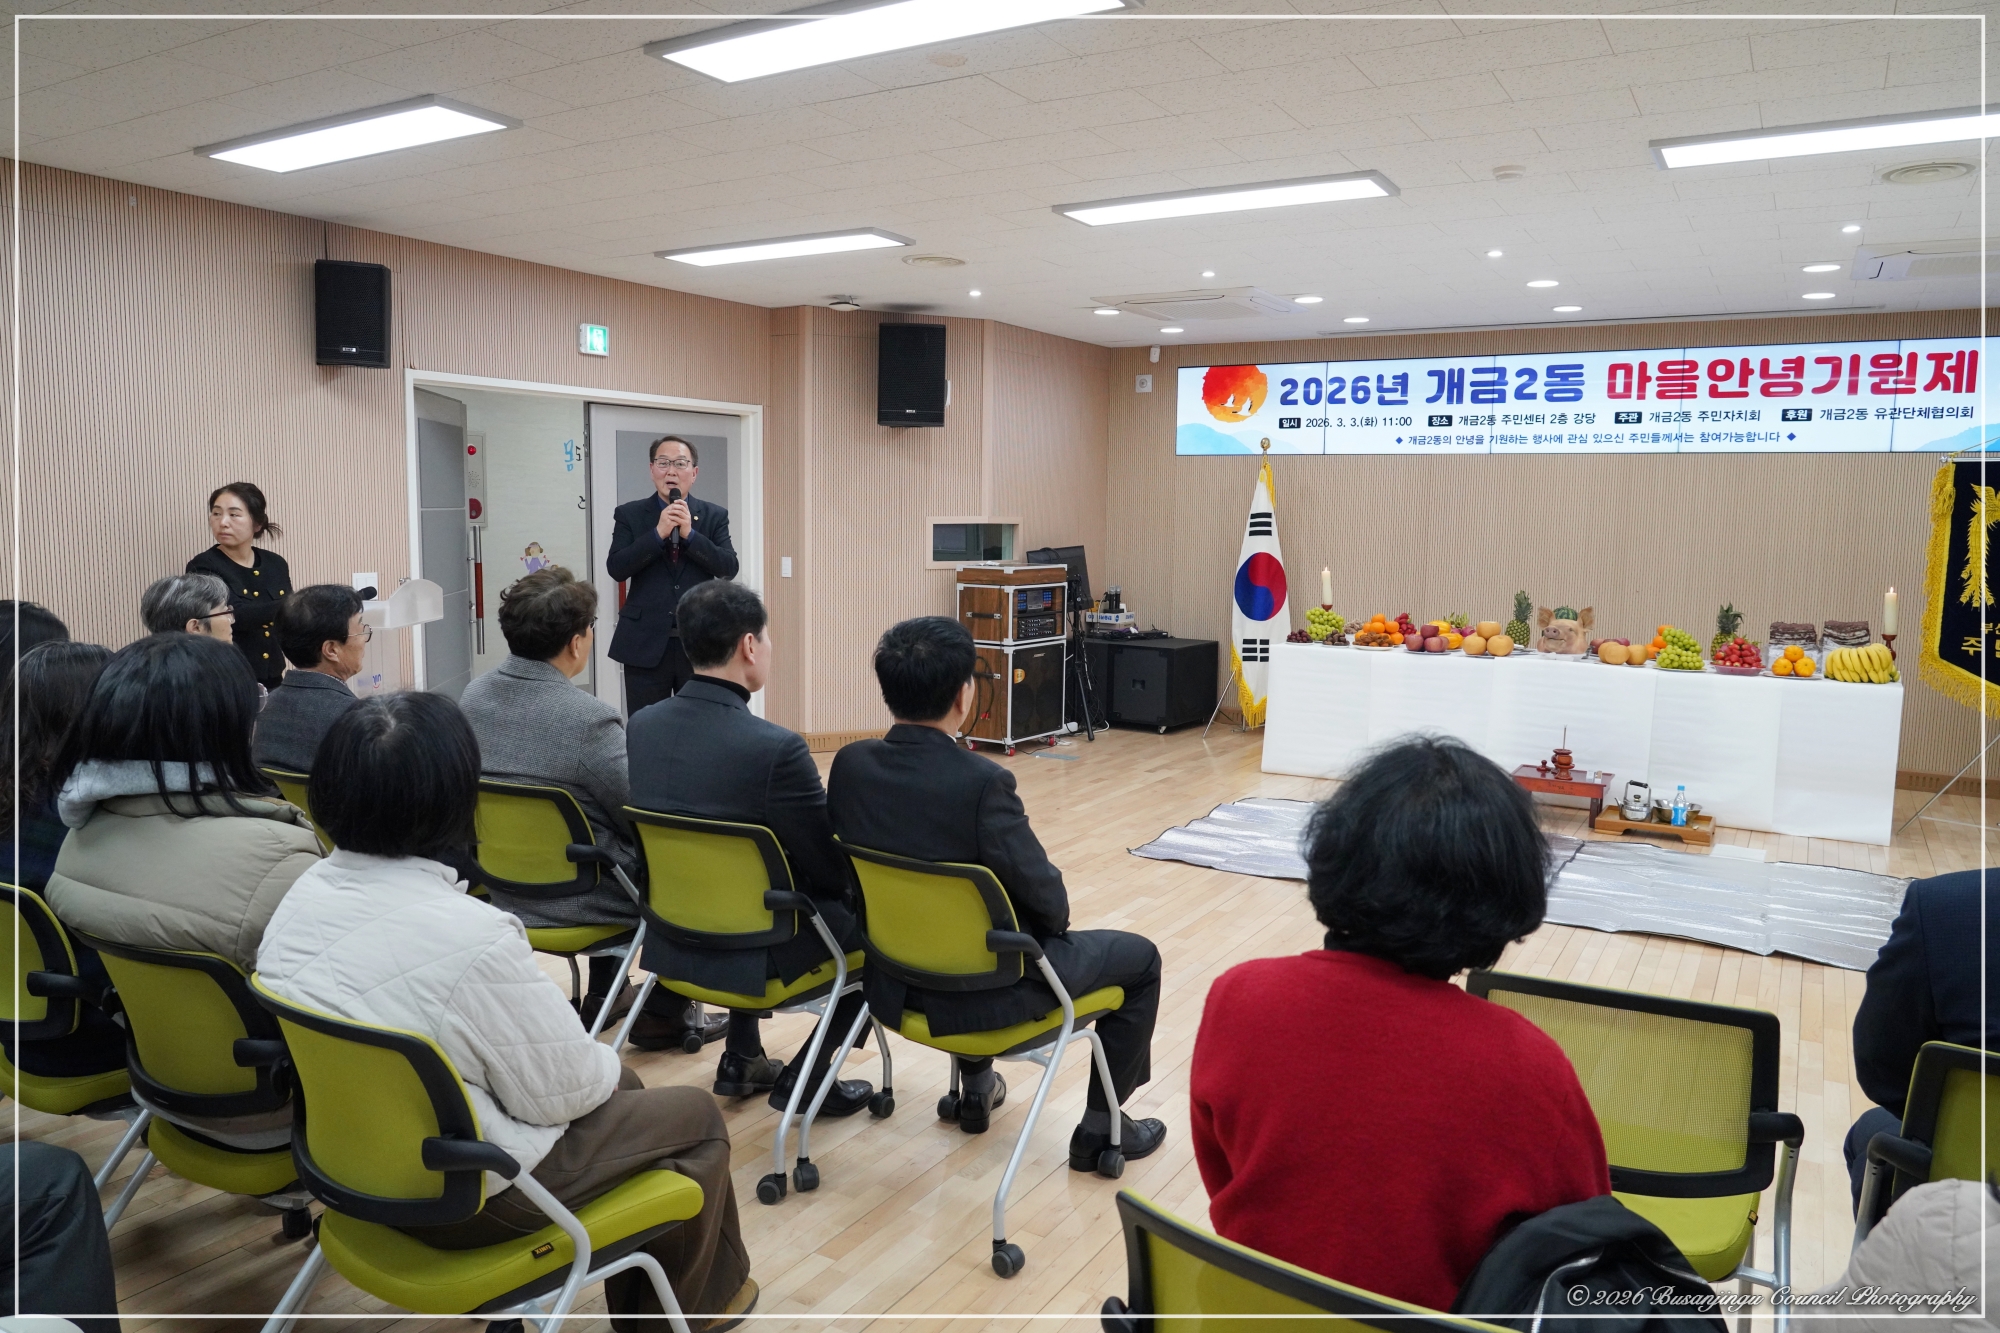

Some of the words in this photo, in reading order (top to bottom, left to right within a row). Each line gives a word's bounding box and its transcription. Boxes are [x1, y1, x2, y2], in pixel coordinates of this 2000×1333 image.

[1280, 372, 1409, 406] 2026년
[1425, 364, 1585, 404] 개금2동
[1607, 350, 1979, 401] 마을안녕기원제
[1282, 419, 1298, 428] 일시
[1305, 418, 1333, 428] 2026.
[1336, 418, 1346, 428] 3.
[1382, 417, 1412, 427] 11:00
[1431, 416, 1449, 425] 장소
[1458, 415, 1497, 426] 개금2동
[1501, 414, 1545, 425] 주민센터
[1550, 414, 1568, 424] 2층
[1573, 413, 1596, 424] 강당
[1618, 413, 1638, 422] 주관
[1649, 412, 1692, 423] 개금2동
[1697, 410, 1761, 422] 주민자치회
[1785, 410, 1808, 420] 후원
[1820, 408, 1869, 420] 개금2동
[1874, 406, 1974, 420] 유관단체협의회
[1408, 435, 1452, 445] 개금2동의
[1455, 435, 1485, 445] 안녕을
[1489, 434, 1529, 445] 기원하는
[1532, 434, 1563, 444] 행사에
[1567, 434, 1588, 444] 관심
[1593, 433, 1624, 443] 있으신
[1628, 432, 1695, 443] 주민들께서는
[1699, 431, 1780, 443] 참여가능합니다
